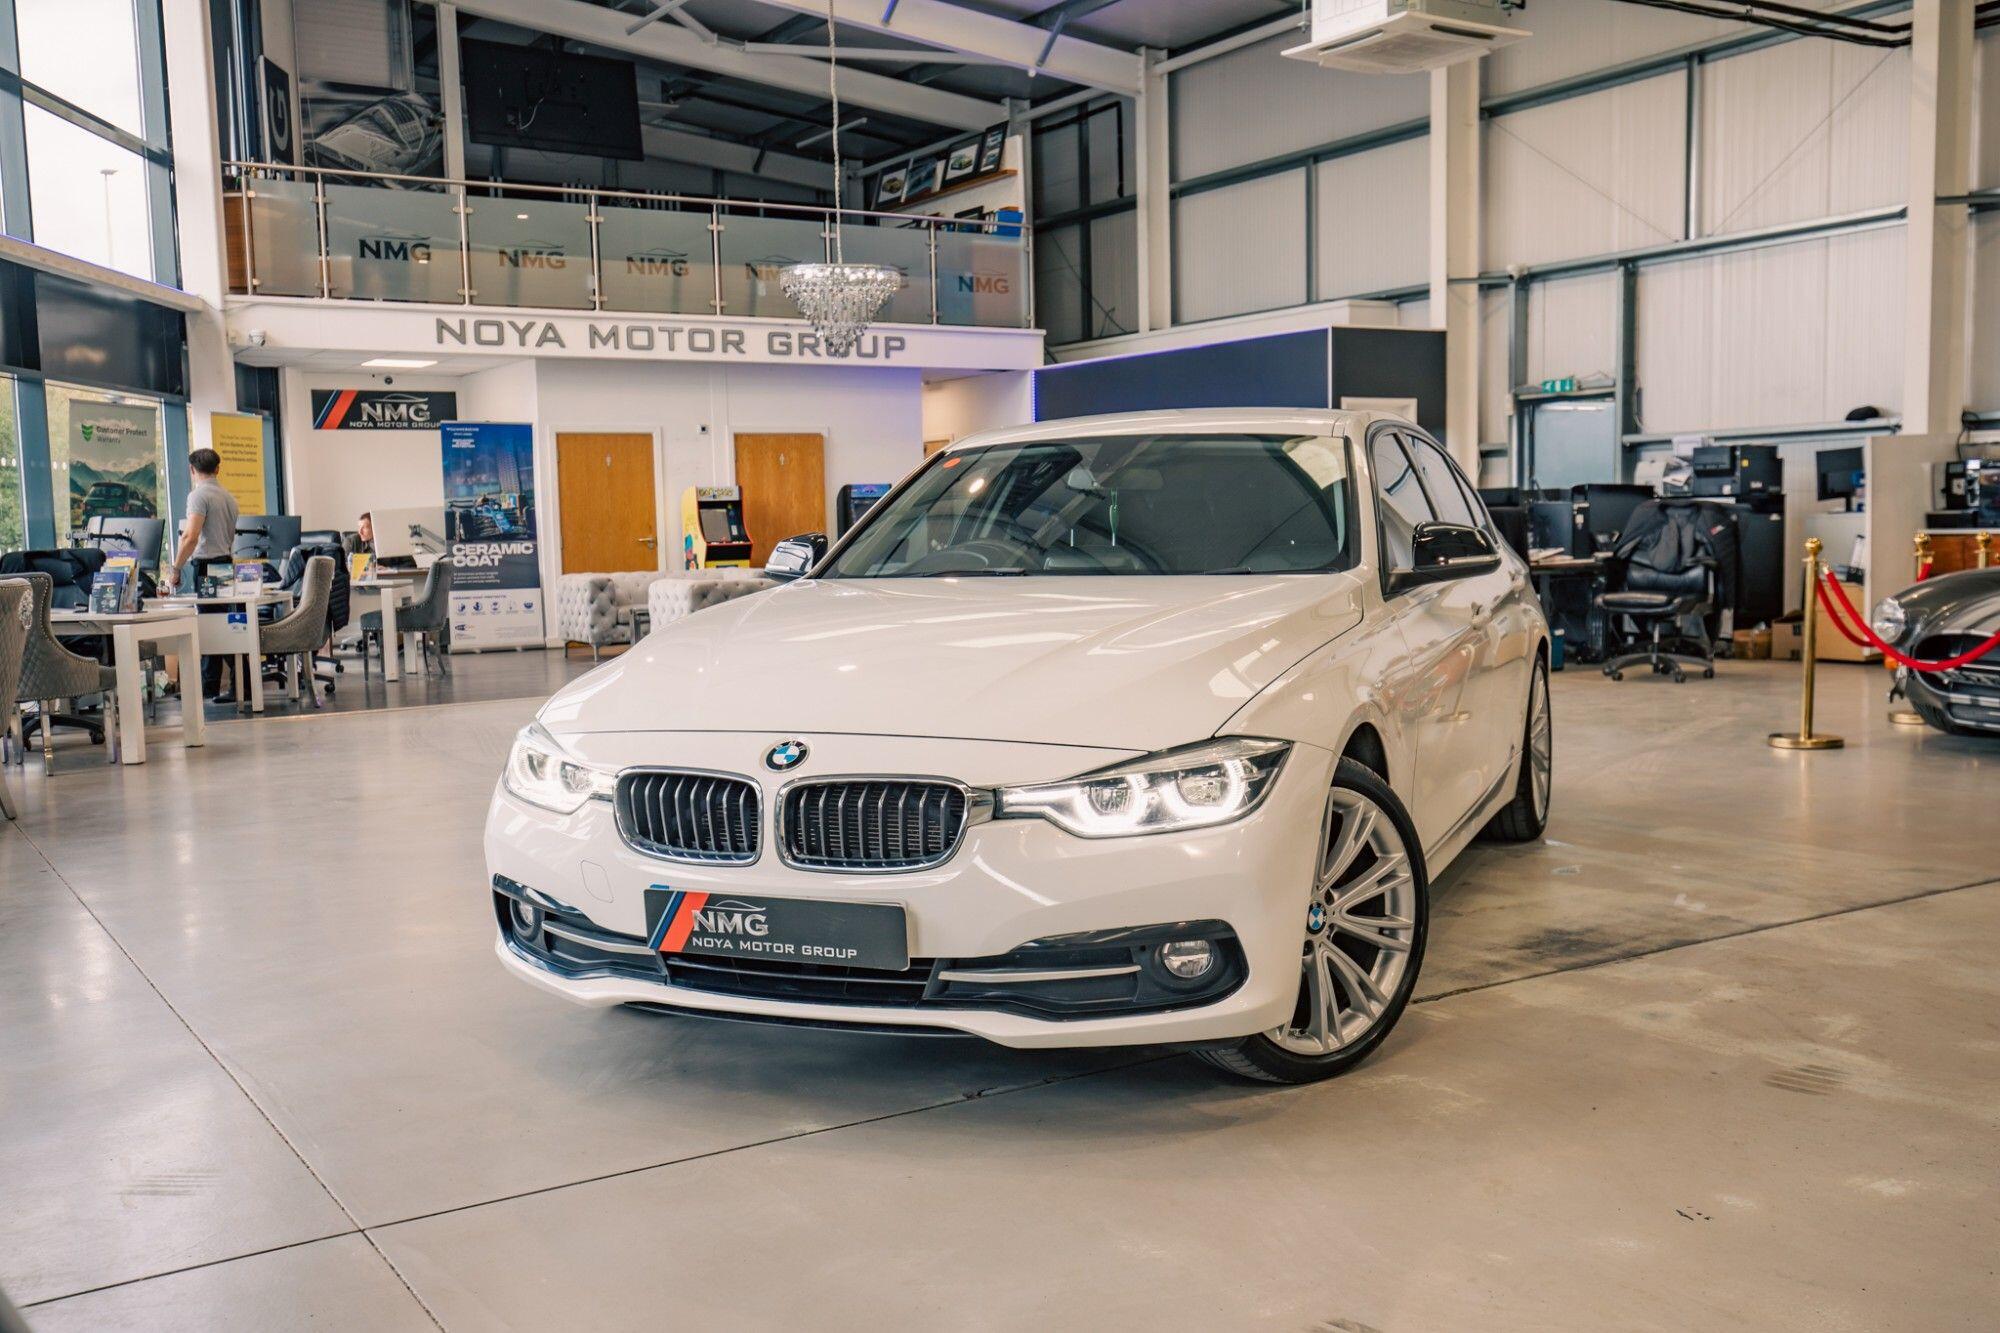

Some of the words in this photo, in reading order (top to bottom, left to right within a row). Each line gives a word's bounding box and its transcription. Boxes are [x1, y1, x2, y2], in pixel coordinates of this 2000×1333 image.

[358, 239, 432, 261] NMG
[498, 250, 566, 269] NMG
[626, 256, 690, 276] NMG
[958, 275, 1009, 294] NMG
[436, 317, 566, 348] NOYA
[588, 323, 745, 354] MOTOR
[361, 402, 431, 422] NMG
[452, 542, 534, 555] CERAMIC
[452, 555, 502, 567] COAT
[692, 909, 769, 936] NMG
[692, 937, 734, 949] NOYA
[739, 940, 795, 954] MOTOR
[802, 945, 857, 959] GROUP
